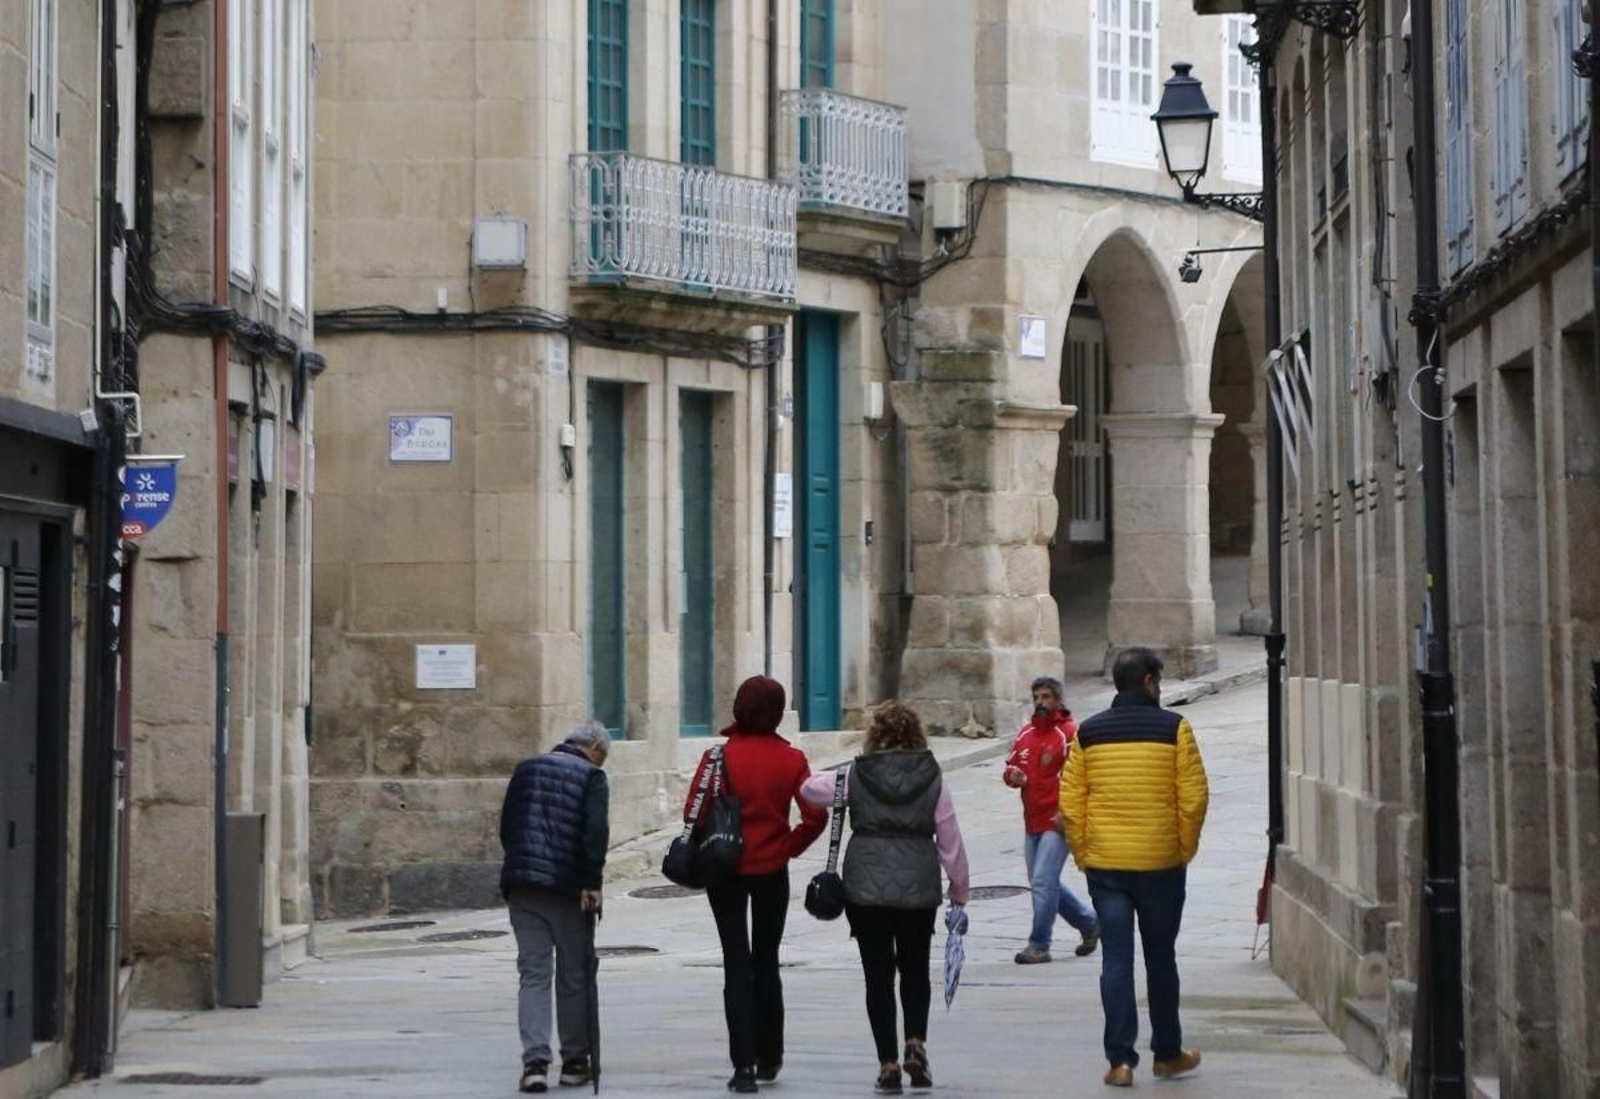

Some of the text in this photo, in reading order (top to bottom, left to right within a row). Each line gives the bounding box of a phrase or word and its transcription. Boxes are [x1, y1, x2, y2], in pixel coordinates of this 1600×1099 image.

[124, 492, 170, 502] orense
[688, 792, 705, 819] BIMBA
[699, 763, 715, 789] BIMBA
[835, 779, 845, 808] BIMBA
[831, 812, 841, 841] BIMBA
